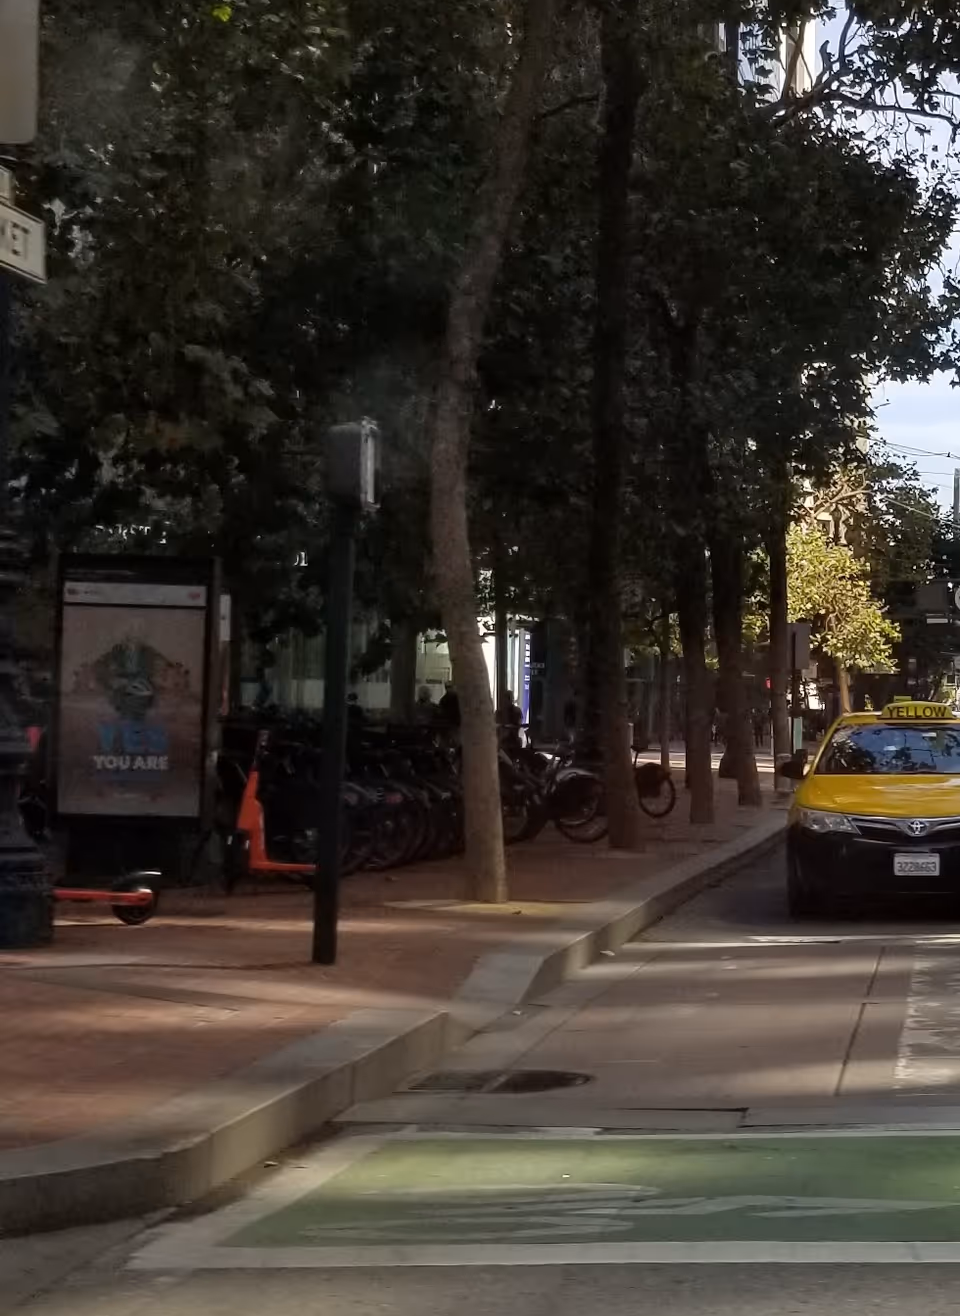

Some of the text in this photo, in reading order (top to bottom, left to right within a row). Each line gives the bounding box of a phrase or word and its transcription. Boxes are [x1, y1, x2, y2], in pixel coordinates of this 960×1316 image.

[887, 706, 947, 718] YELLOW
[93, 755, 169, 770] YOU ARE
